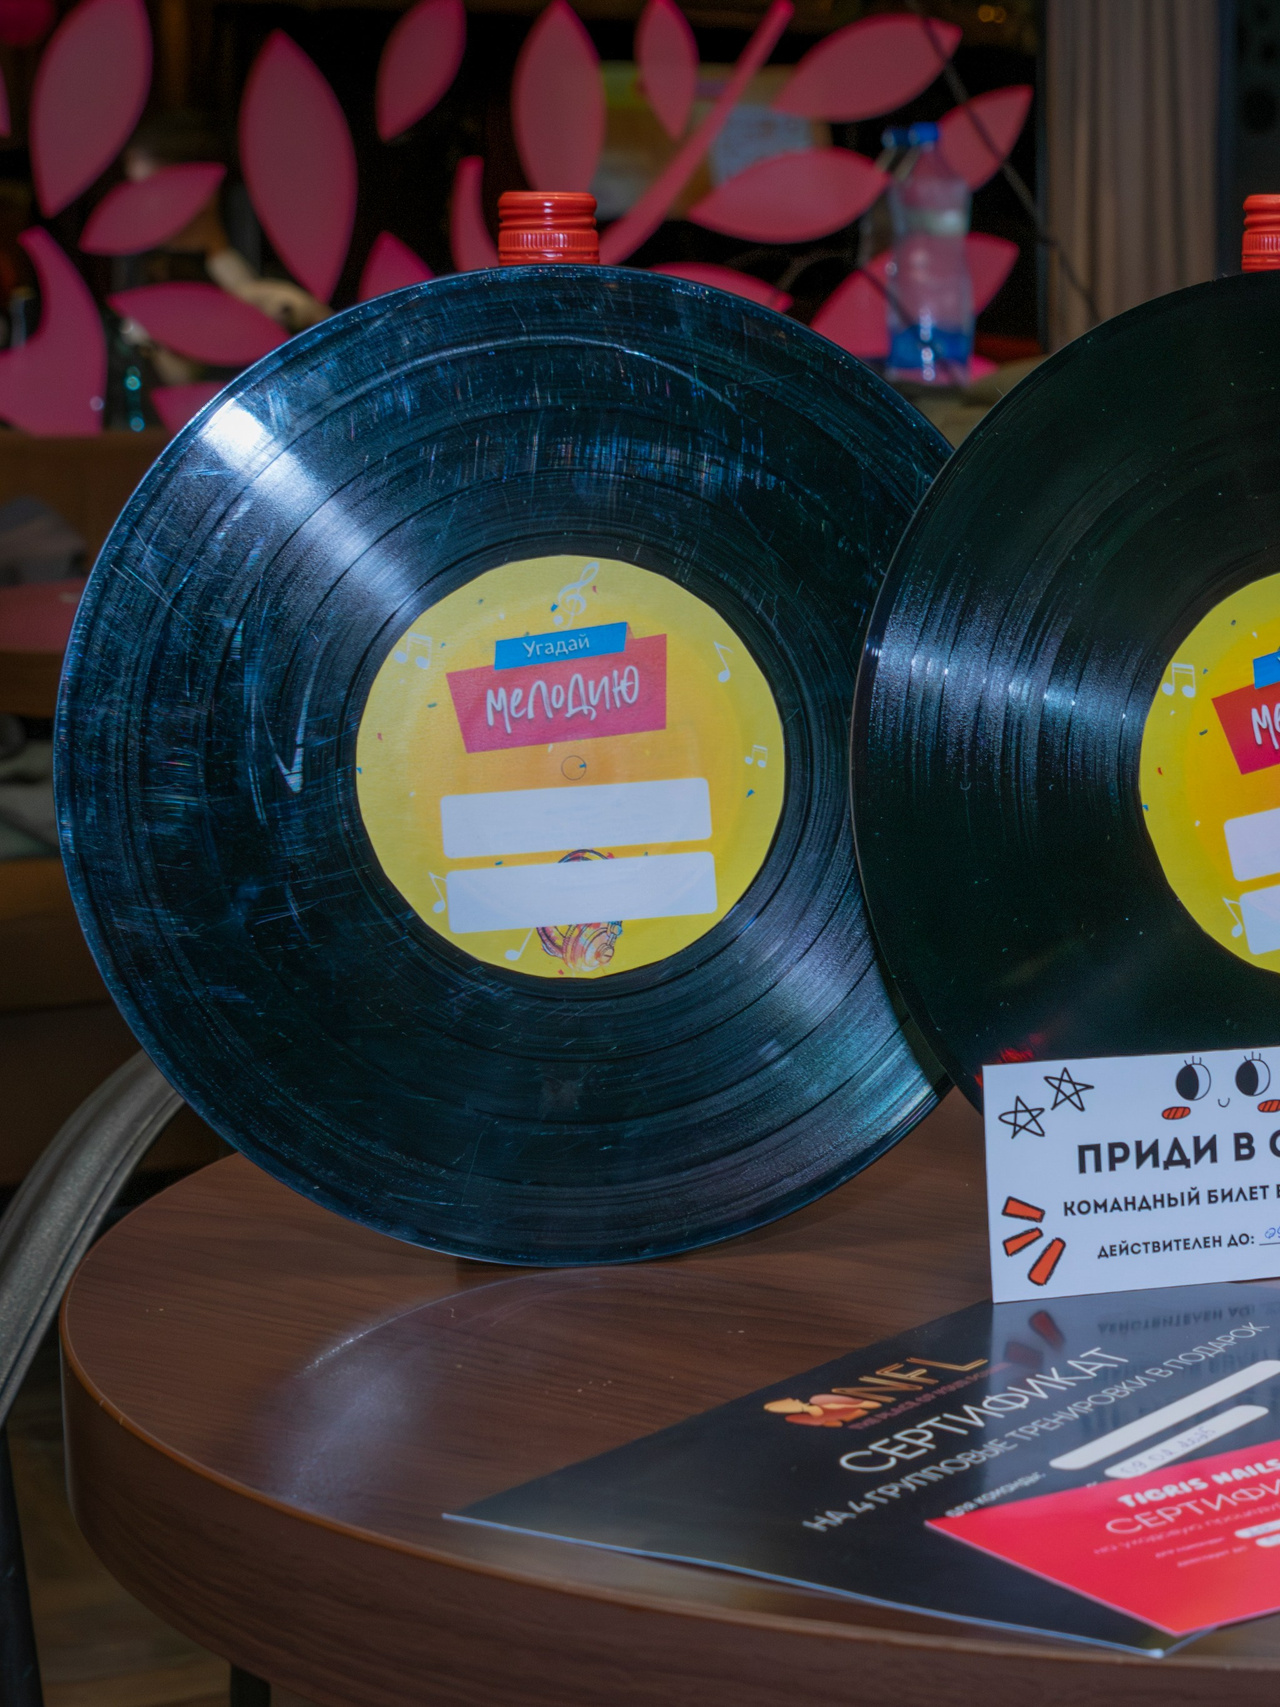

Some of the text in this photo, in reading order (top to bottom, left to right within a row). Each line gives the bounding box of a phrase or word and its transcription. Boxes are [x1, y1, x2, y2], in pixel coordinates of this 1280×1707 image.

[523, 634, 590, 658] Угадай
[1078, 1134, 1218, 1174] ПРИДИ
[1233, 1132, 1256, 1162] В
[1063, 1187, 1201, 1217] КОМАНДНЫЙ
[1207, 1184, 1270, 1206] БИЛЕТ
[1097, 1232, 1255, 1260] ДЕЙСТВИТЕЛЕН ДО:
[832, 1357, 988, 1403] NFL
[802, 1509, 857, 1532] НА
[848, 1500, 877, 1516] 4
[864, 1438, 1019, 1504] ГРУППОВЫЕ
[1005, 1375, 1157, 1441] ТРЕНИРОВКИ
[1144, 1366, 1175, 1379] В
[1163, 1322, 1270, 1371] ПОДАРОК
[840, 1347, 1129, 1472] СЕРТИФИКАТ
[1117, 1477, 1209, 1508] TIGRIS
